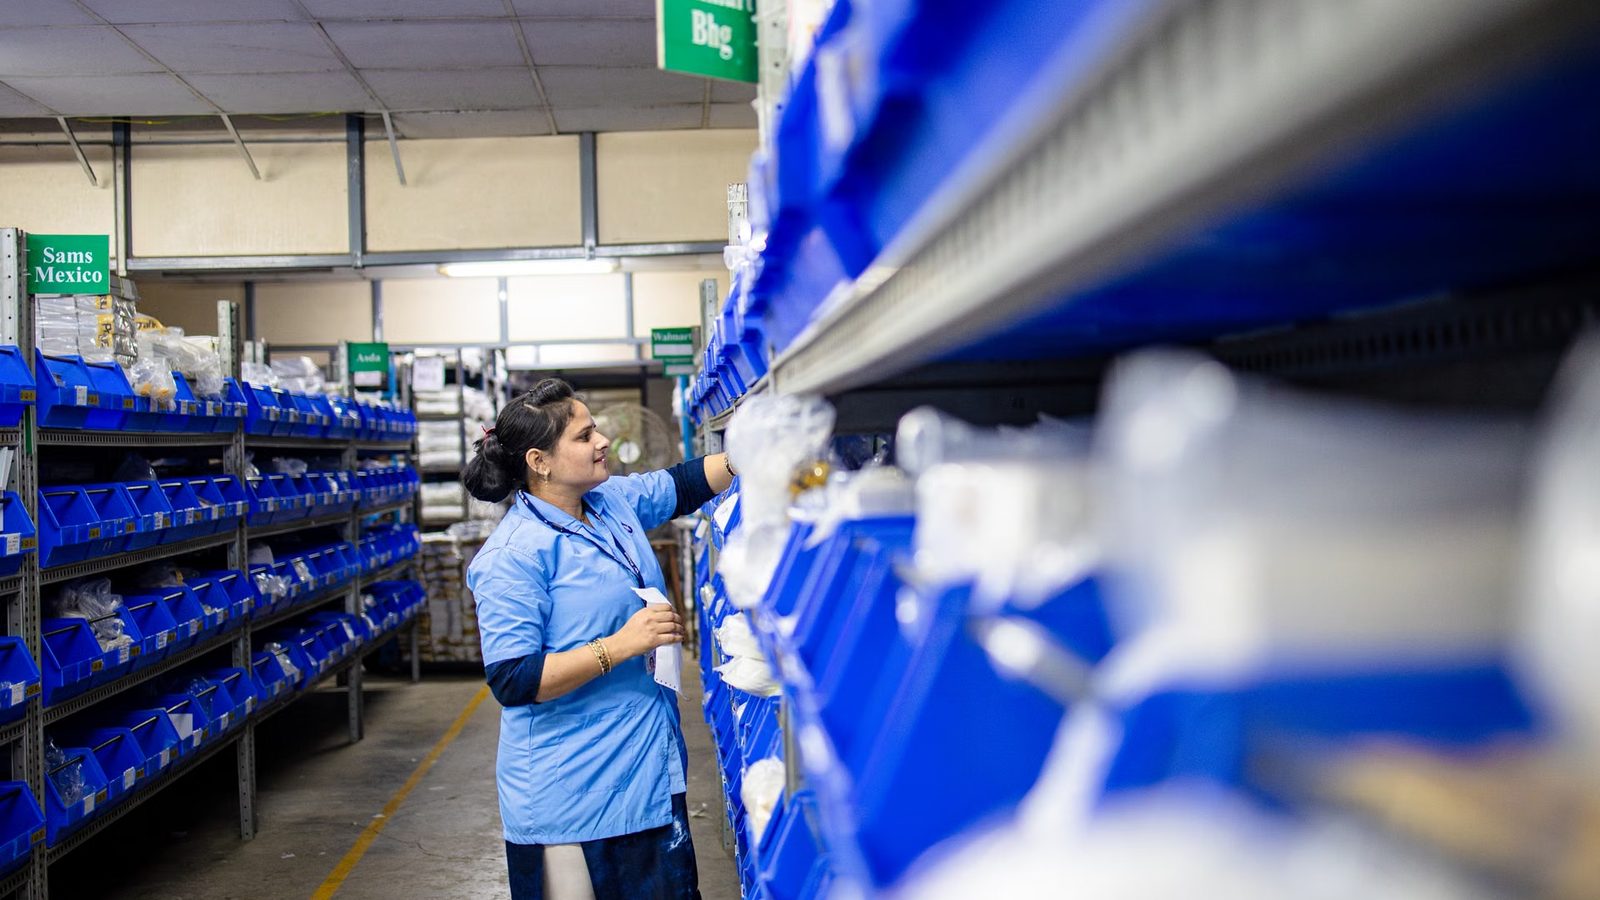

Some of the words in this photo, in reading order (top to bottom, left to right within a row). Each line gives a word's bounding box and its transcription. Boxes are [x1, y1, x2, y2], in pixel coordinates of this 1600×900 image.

[691, 8, 733, 60] Bhg
[43, 246, 93, 264] Sams
[35, 266, 103, 283] Mexico
[652, 332, 692, 341] Walmart
